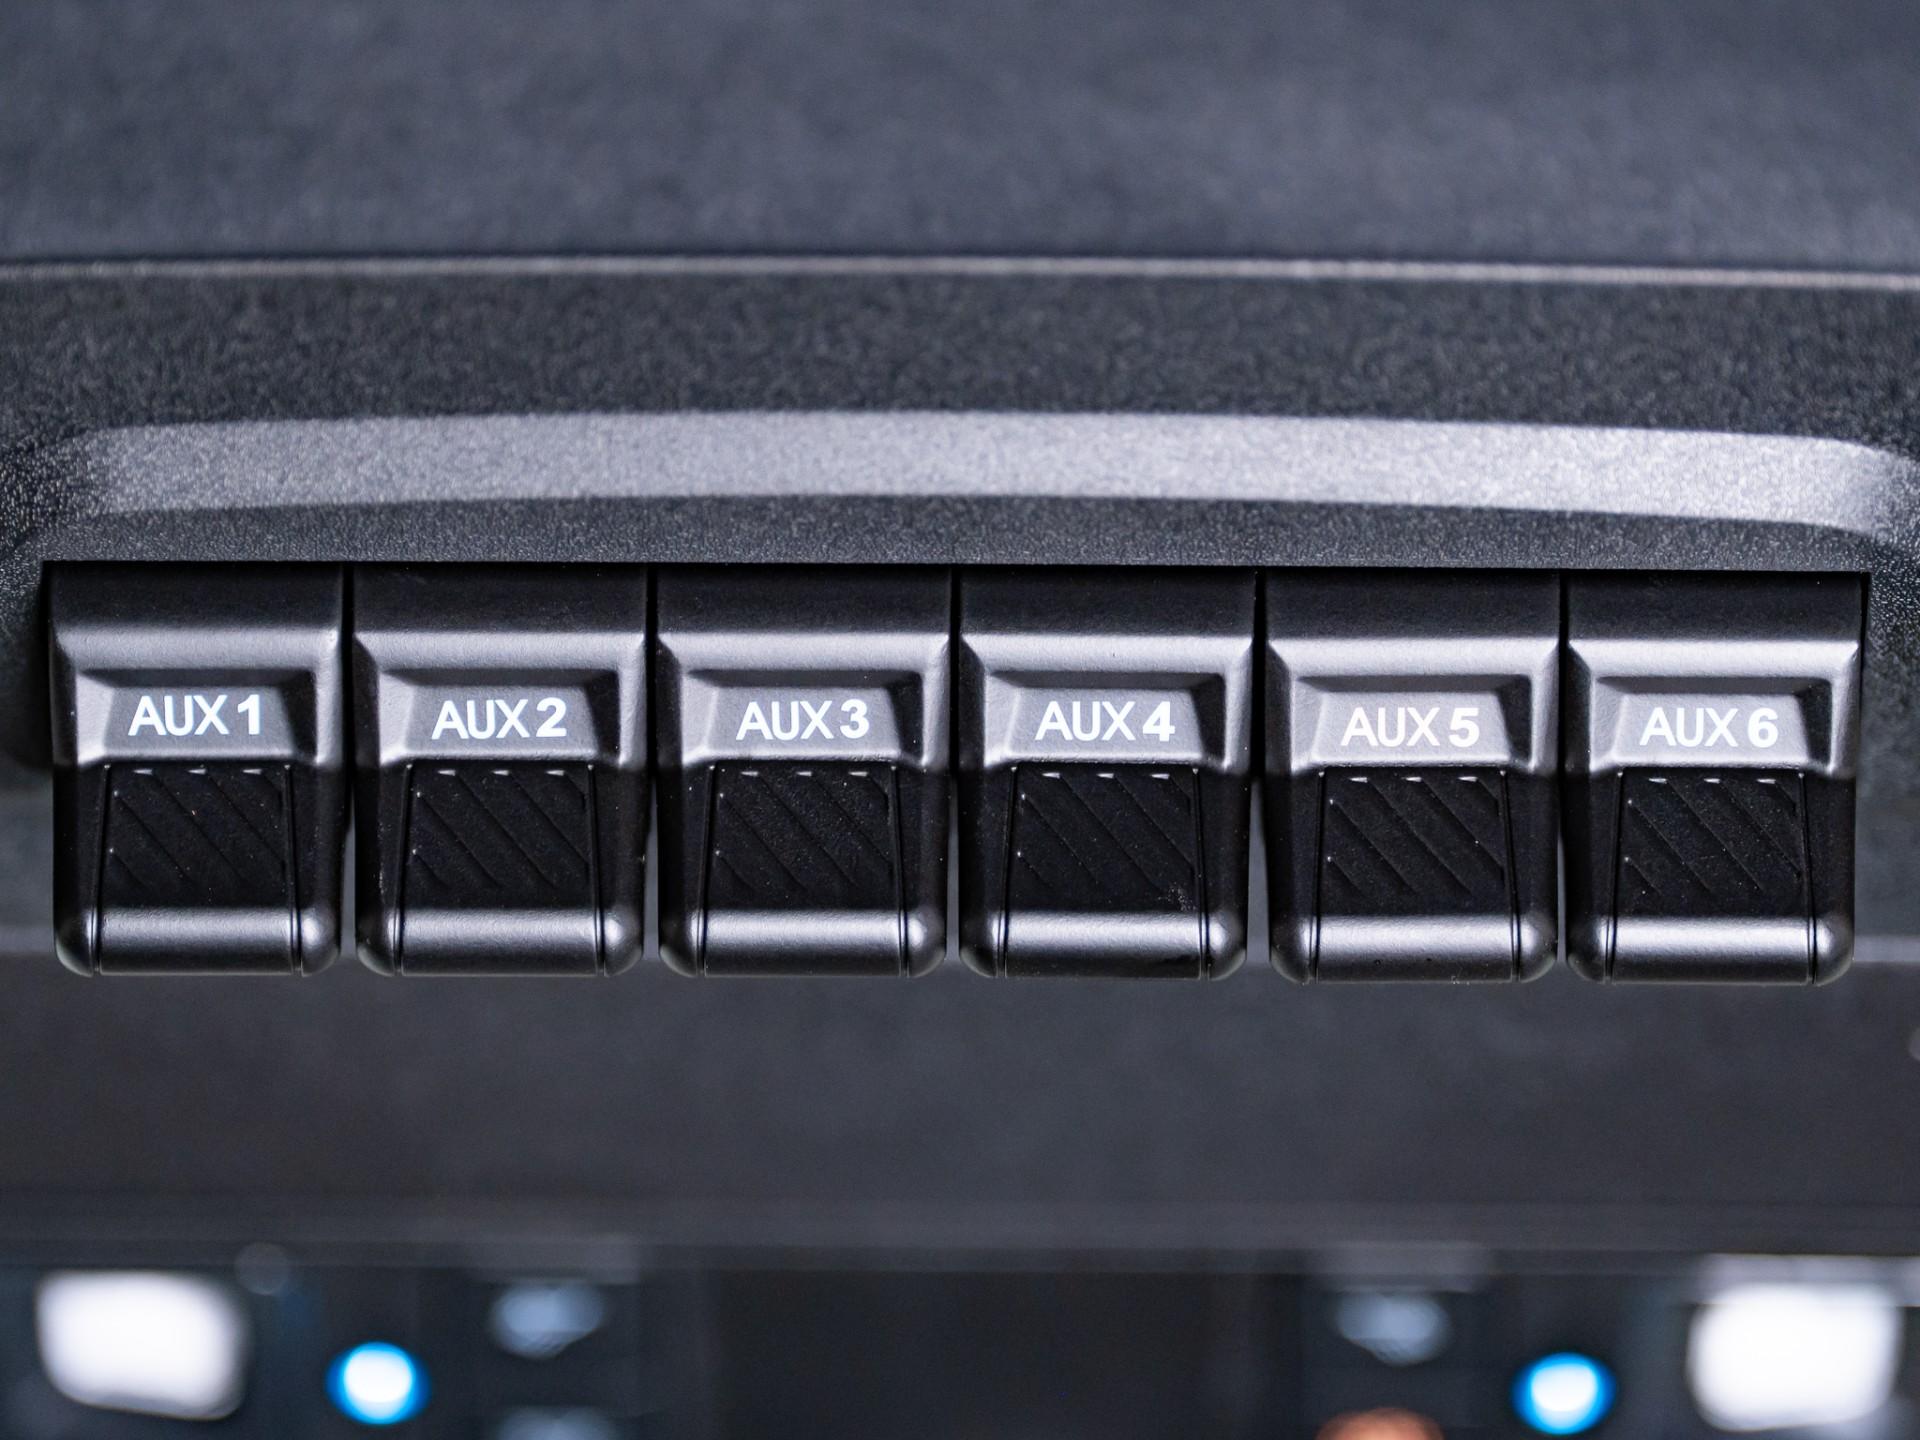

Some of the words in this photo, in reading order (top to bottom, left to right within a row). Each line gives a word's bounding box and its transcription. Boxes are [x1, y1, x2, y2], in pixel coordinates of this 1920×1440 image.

[128, 695, 229, 736] AUX
[236, 694, 261, 735] 1
[431, 699, 530, 739] AUX
[536, 697, 567, 737] 2
[736, 701, 834, 741] AUX
[840, 699, 870, 739] 3
[1035, 701, 1136, 741] AUX
[1142, 700, 1176, 742] 4
[1340, 707, 1440, 747] AUX
[1448, 707, 1480, 747] 5
[1639, 707, 1739, 747] AUX
[1746, 707, 1779, 747] 6
